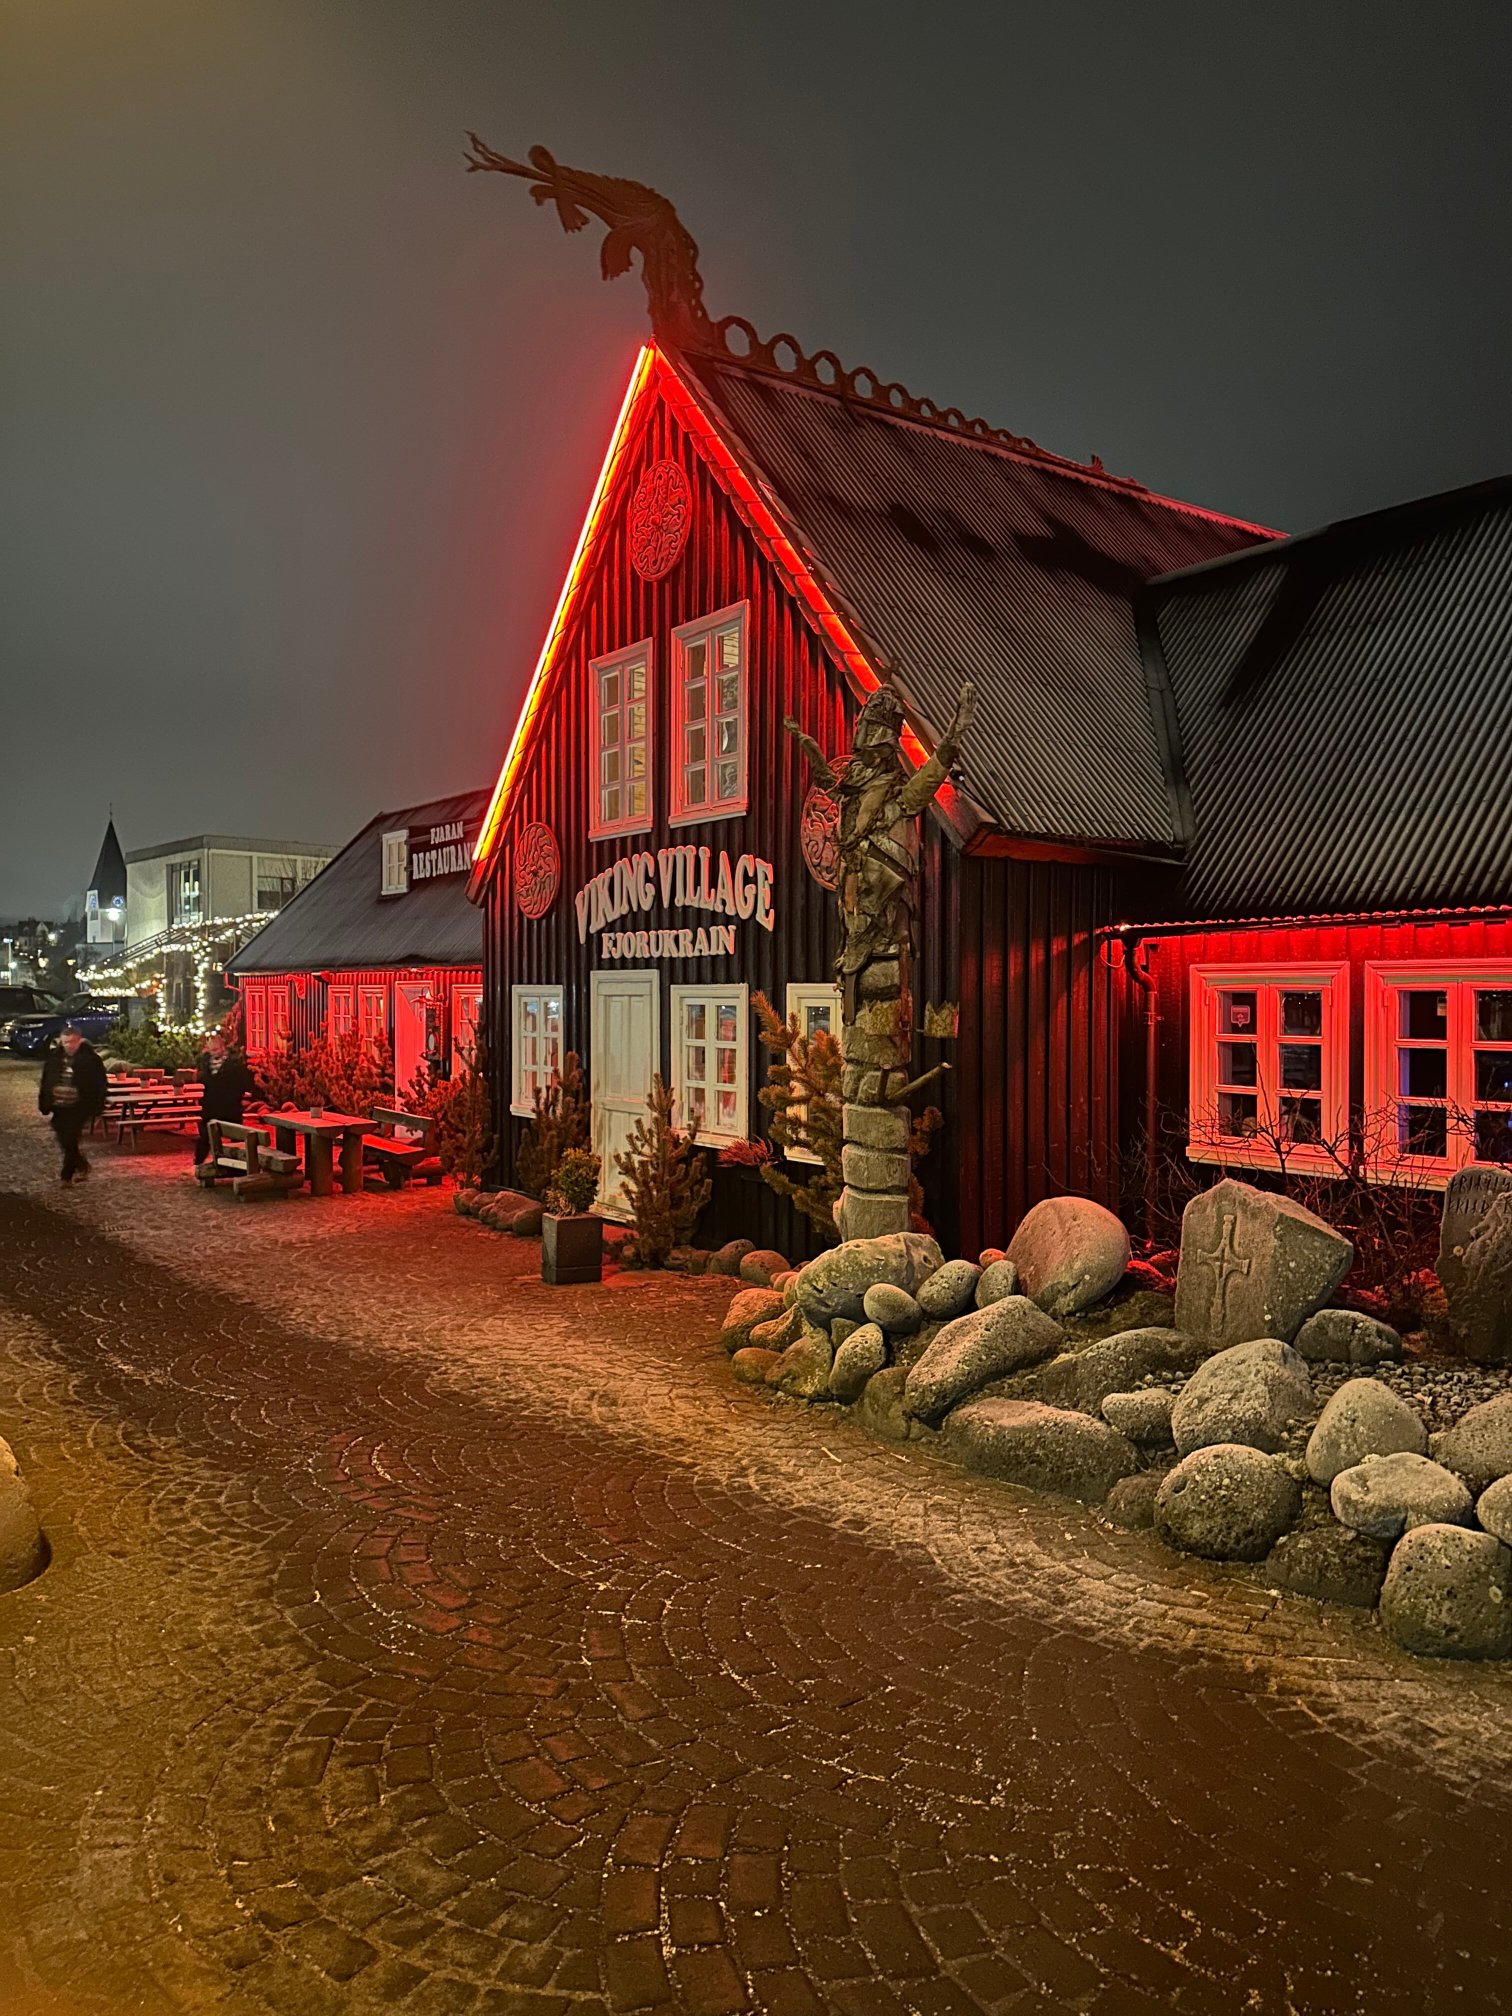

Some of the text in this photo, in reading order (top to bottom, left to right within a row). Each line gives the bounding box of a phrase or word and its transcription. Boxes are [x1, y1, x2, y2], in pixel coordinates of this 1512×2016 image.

[575, 845, 775, 945] VIKING VILLAGE
[601, 925, 737, 959] FJORUKRAIN
